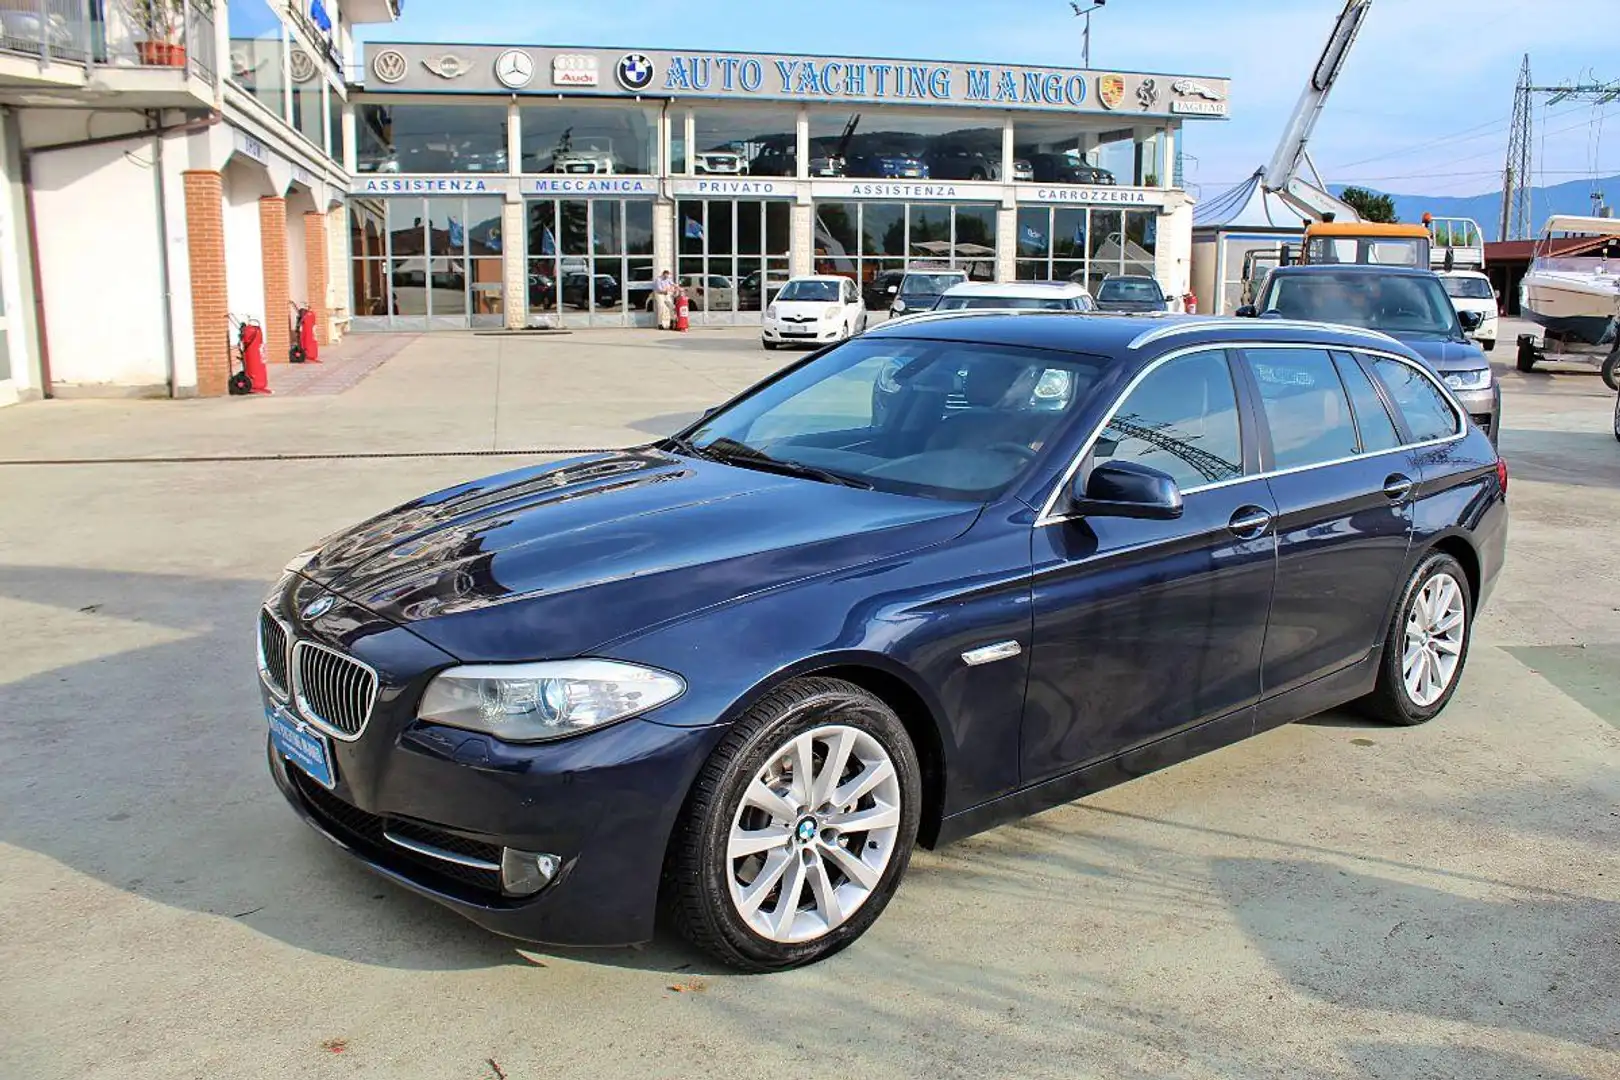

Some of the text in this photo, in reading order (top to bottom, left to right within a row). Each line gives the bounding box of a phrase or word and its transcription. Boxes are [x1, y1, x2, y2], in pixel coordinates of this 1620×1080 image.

[561, 73, 593, 83] Audi
[664, 56, 1087, 106] AUTO YACHTING MANGO
[366, 179, 486, 191] ASSISTENZA
[535, 180, 643, 191] MECCANICA
[699, 182, 774, 193] PRIVATO
[852, 185, 956, 196] ASSISTENZA
[1038, 189, 1145, 202] CARROZZERIA
